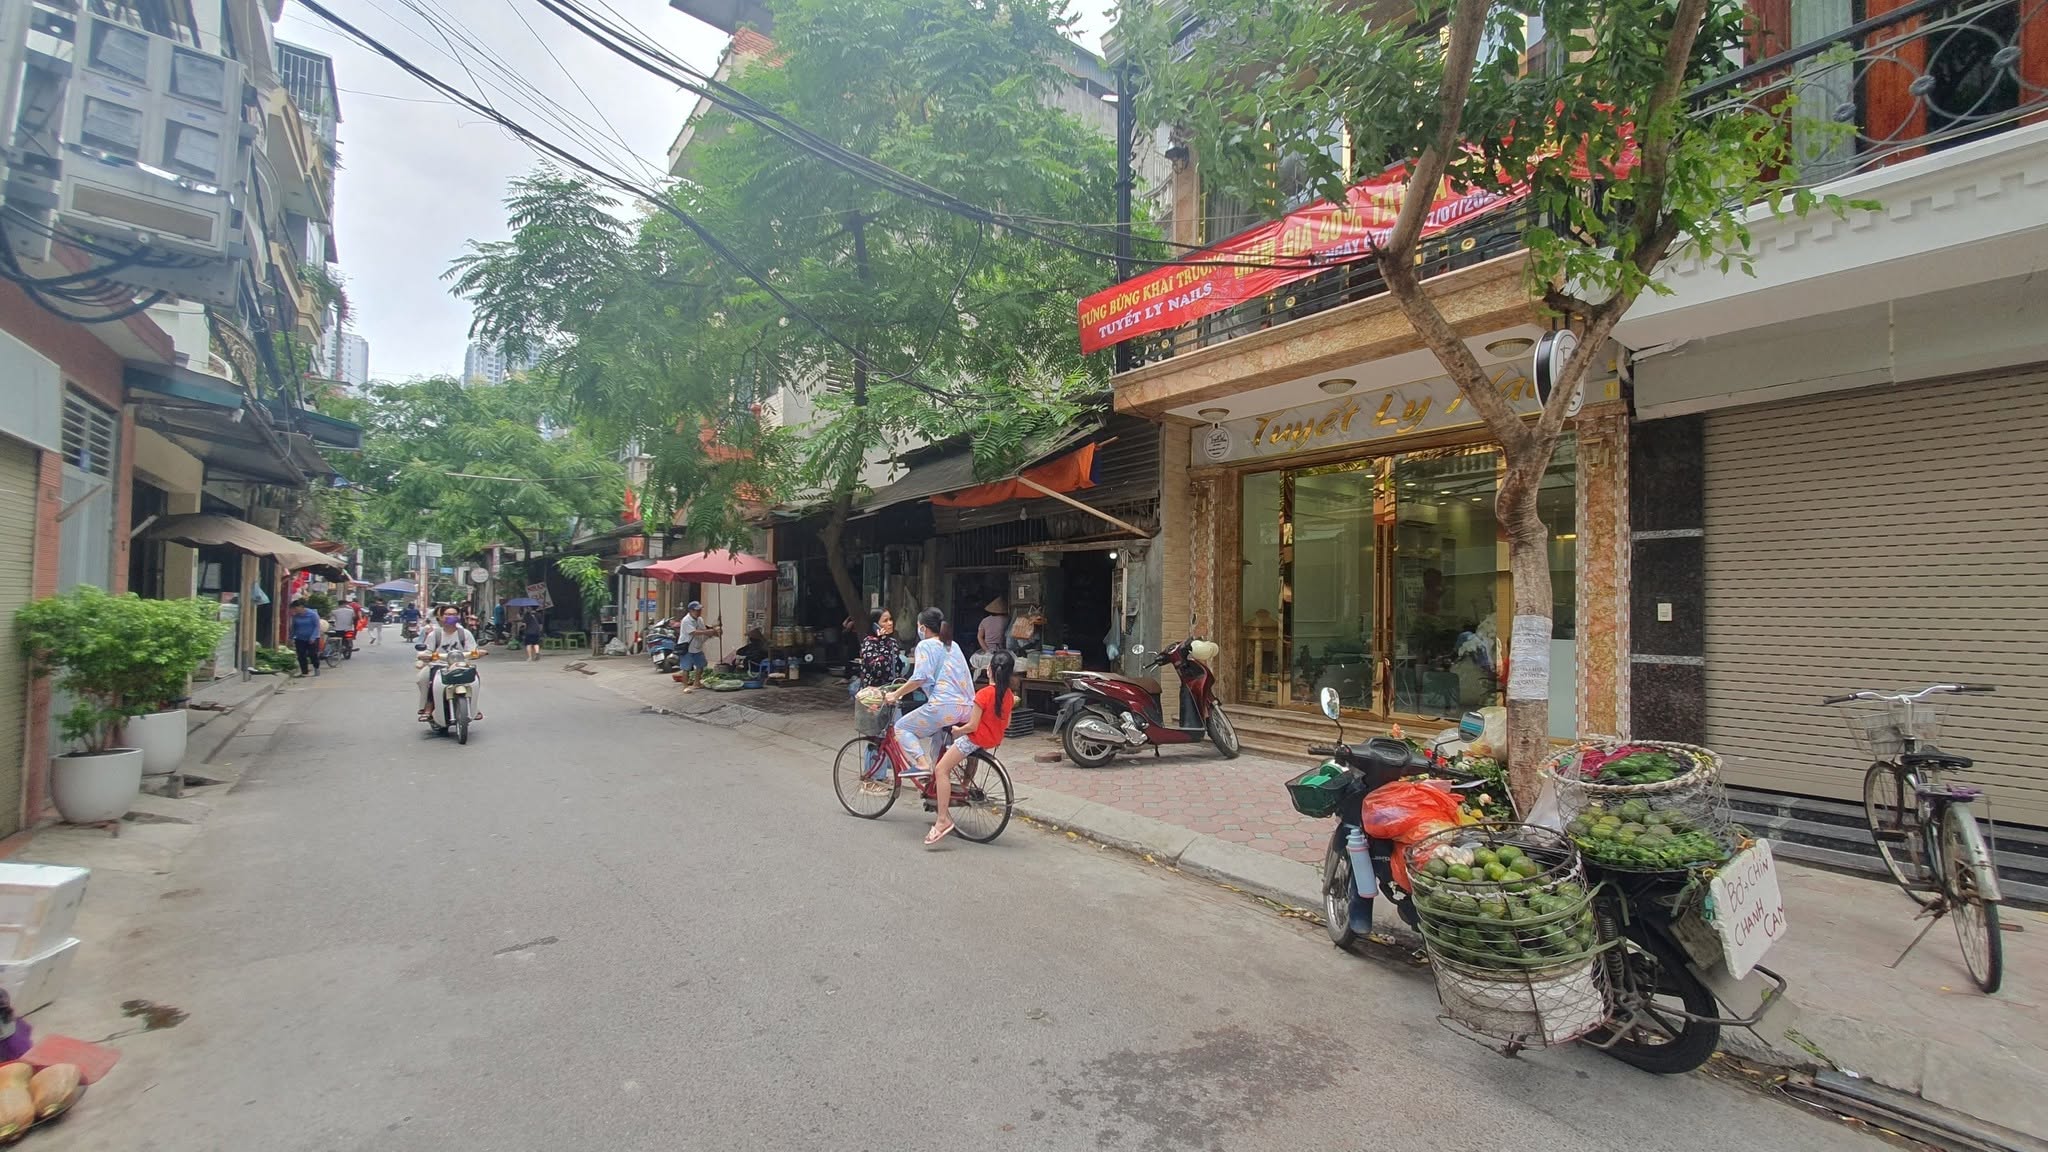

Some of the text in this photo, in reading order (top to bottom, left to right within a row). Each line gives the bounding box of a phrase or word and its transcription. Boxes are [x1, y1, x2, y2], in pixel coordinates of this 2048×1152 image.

[1282, 216, 1313, 257] GIÁ
[1318, 201, 1363, 243] 40%
[1098, 282, 1213, 339] TUYẾT LY NAILS
[1142, 276, 1174, 302] KHAI
[1253, 396, 1361, 454] Tuyết
[1373, 393, 1433, 435] Ly
[1734, 897, 1765, 947] CHANH
